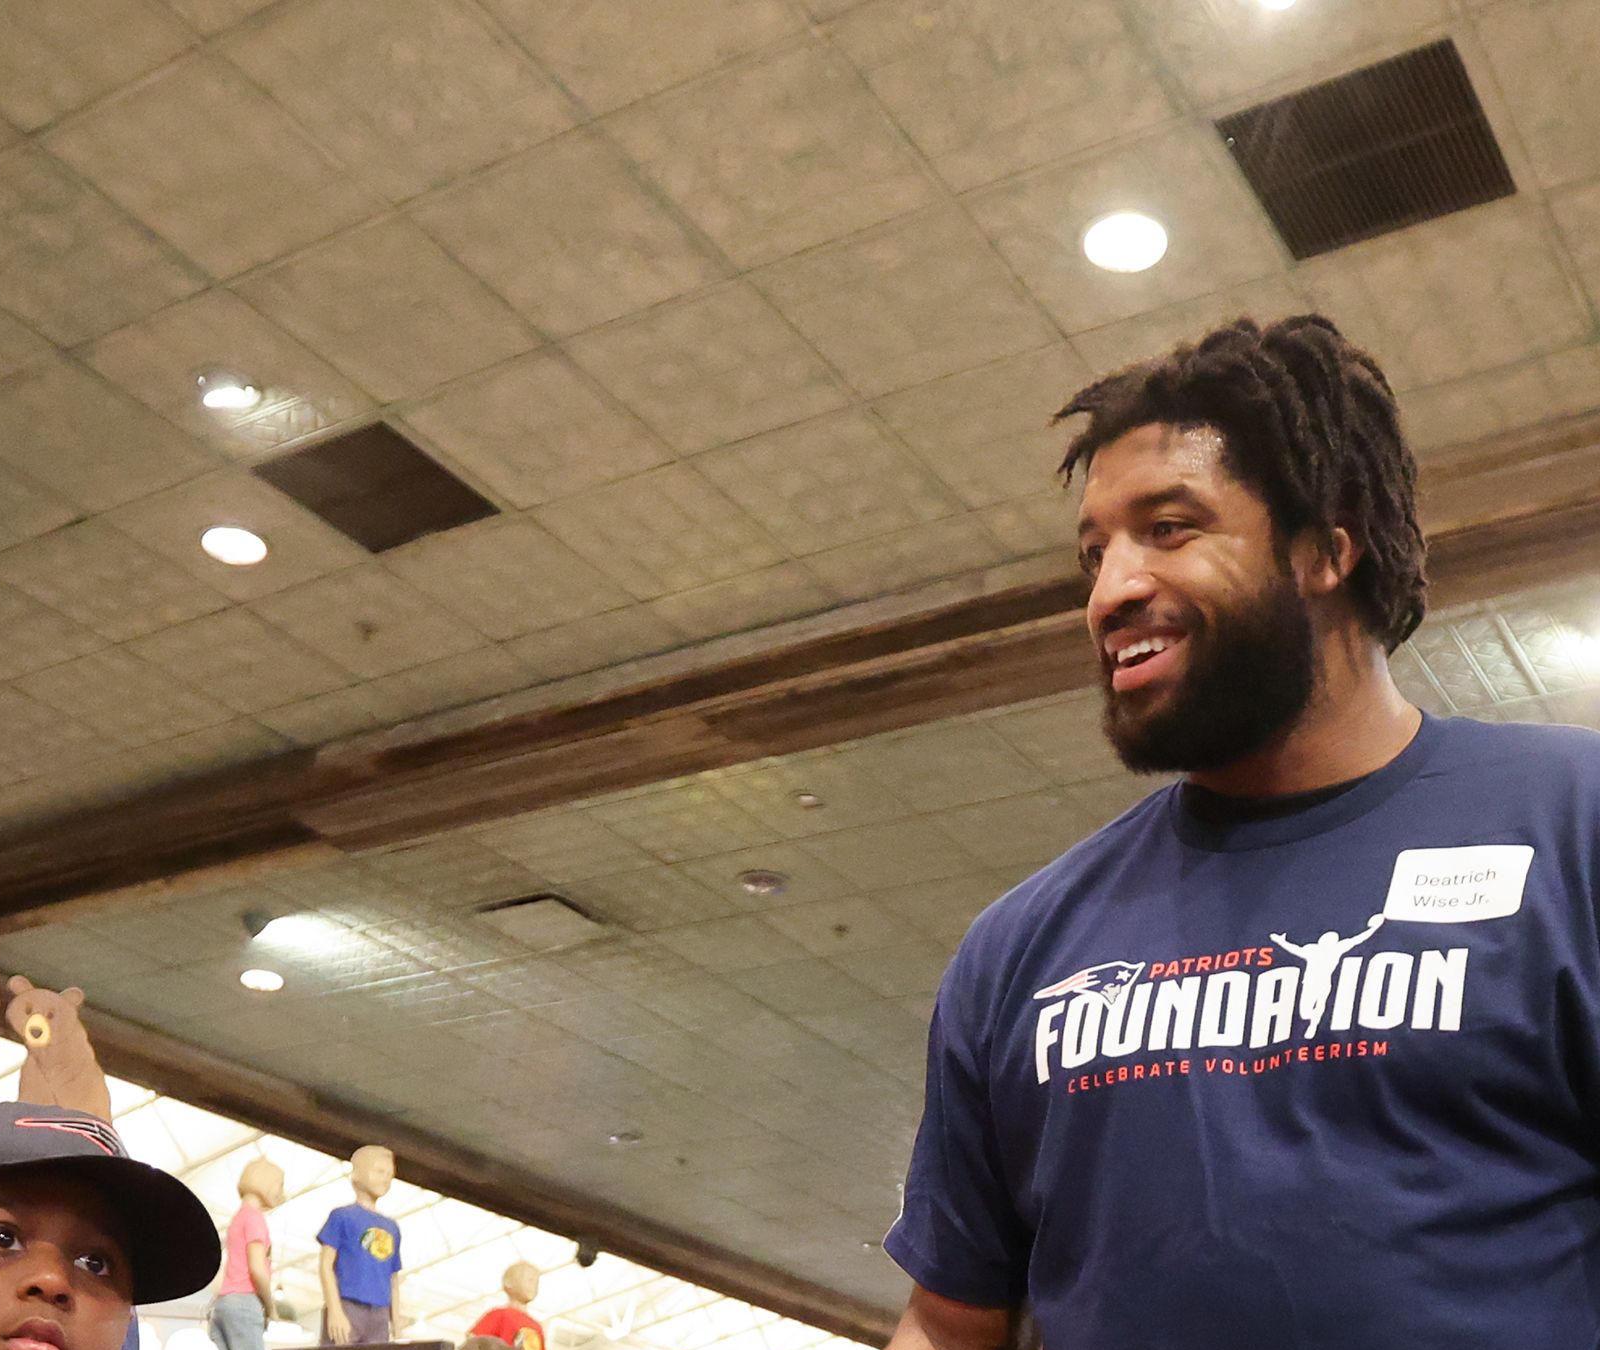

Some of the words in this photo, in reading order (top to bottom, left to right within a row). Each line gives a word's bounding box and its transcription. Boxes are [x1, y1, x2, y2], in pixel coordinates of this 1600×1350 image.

[1414, 868, 1497, 887] Deatrich
[1413, 895, 1460, 908] Wise
[1465, 892, 1490, 906] Jr.
[1149, 947, 1273, 979] PATRIOTS
[1067, 1059, 1190, 1094] CELEBRATE
[1205, 1040, 1390, 1076] VOLUNTEERISM
